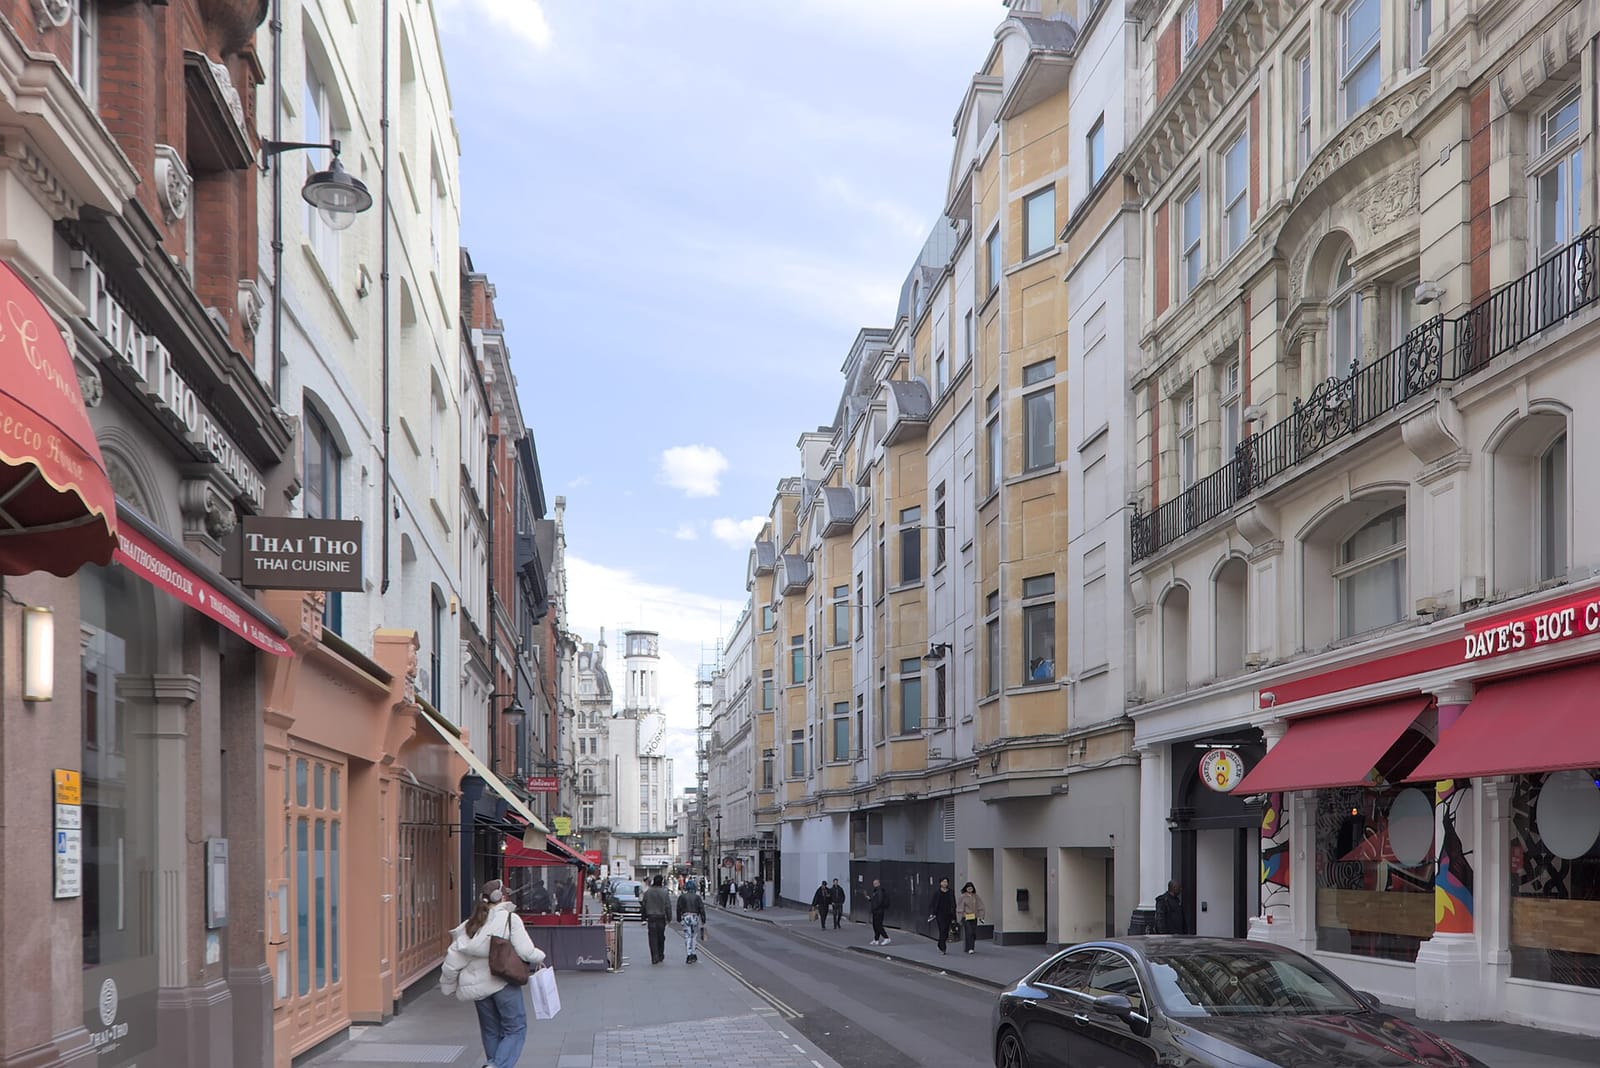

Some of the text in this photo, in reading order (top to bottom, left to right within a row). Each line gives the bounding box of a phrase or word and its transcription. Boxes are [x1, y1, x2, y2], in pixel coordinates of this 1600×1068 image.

[71, 250, 267, 510] THAI THO RESTAURANT
[254, 558, 351, 573] THAI CUISINE
[1464, 602, 1600, 660] DAVE'S HOT C
